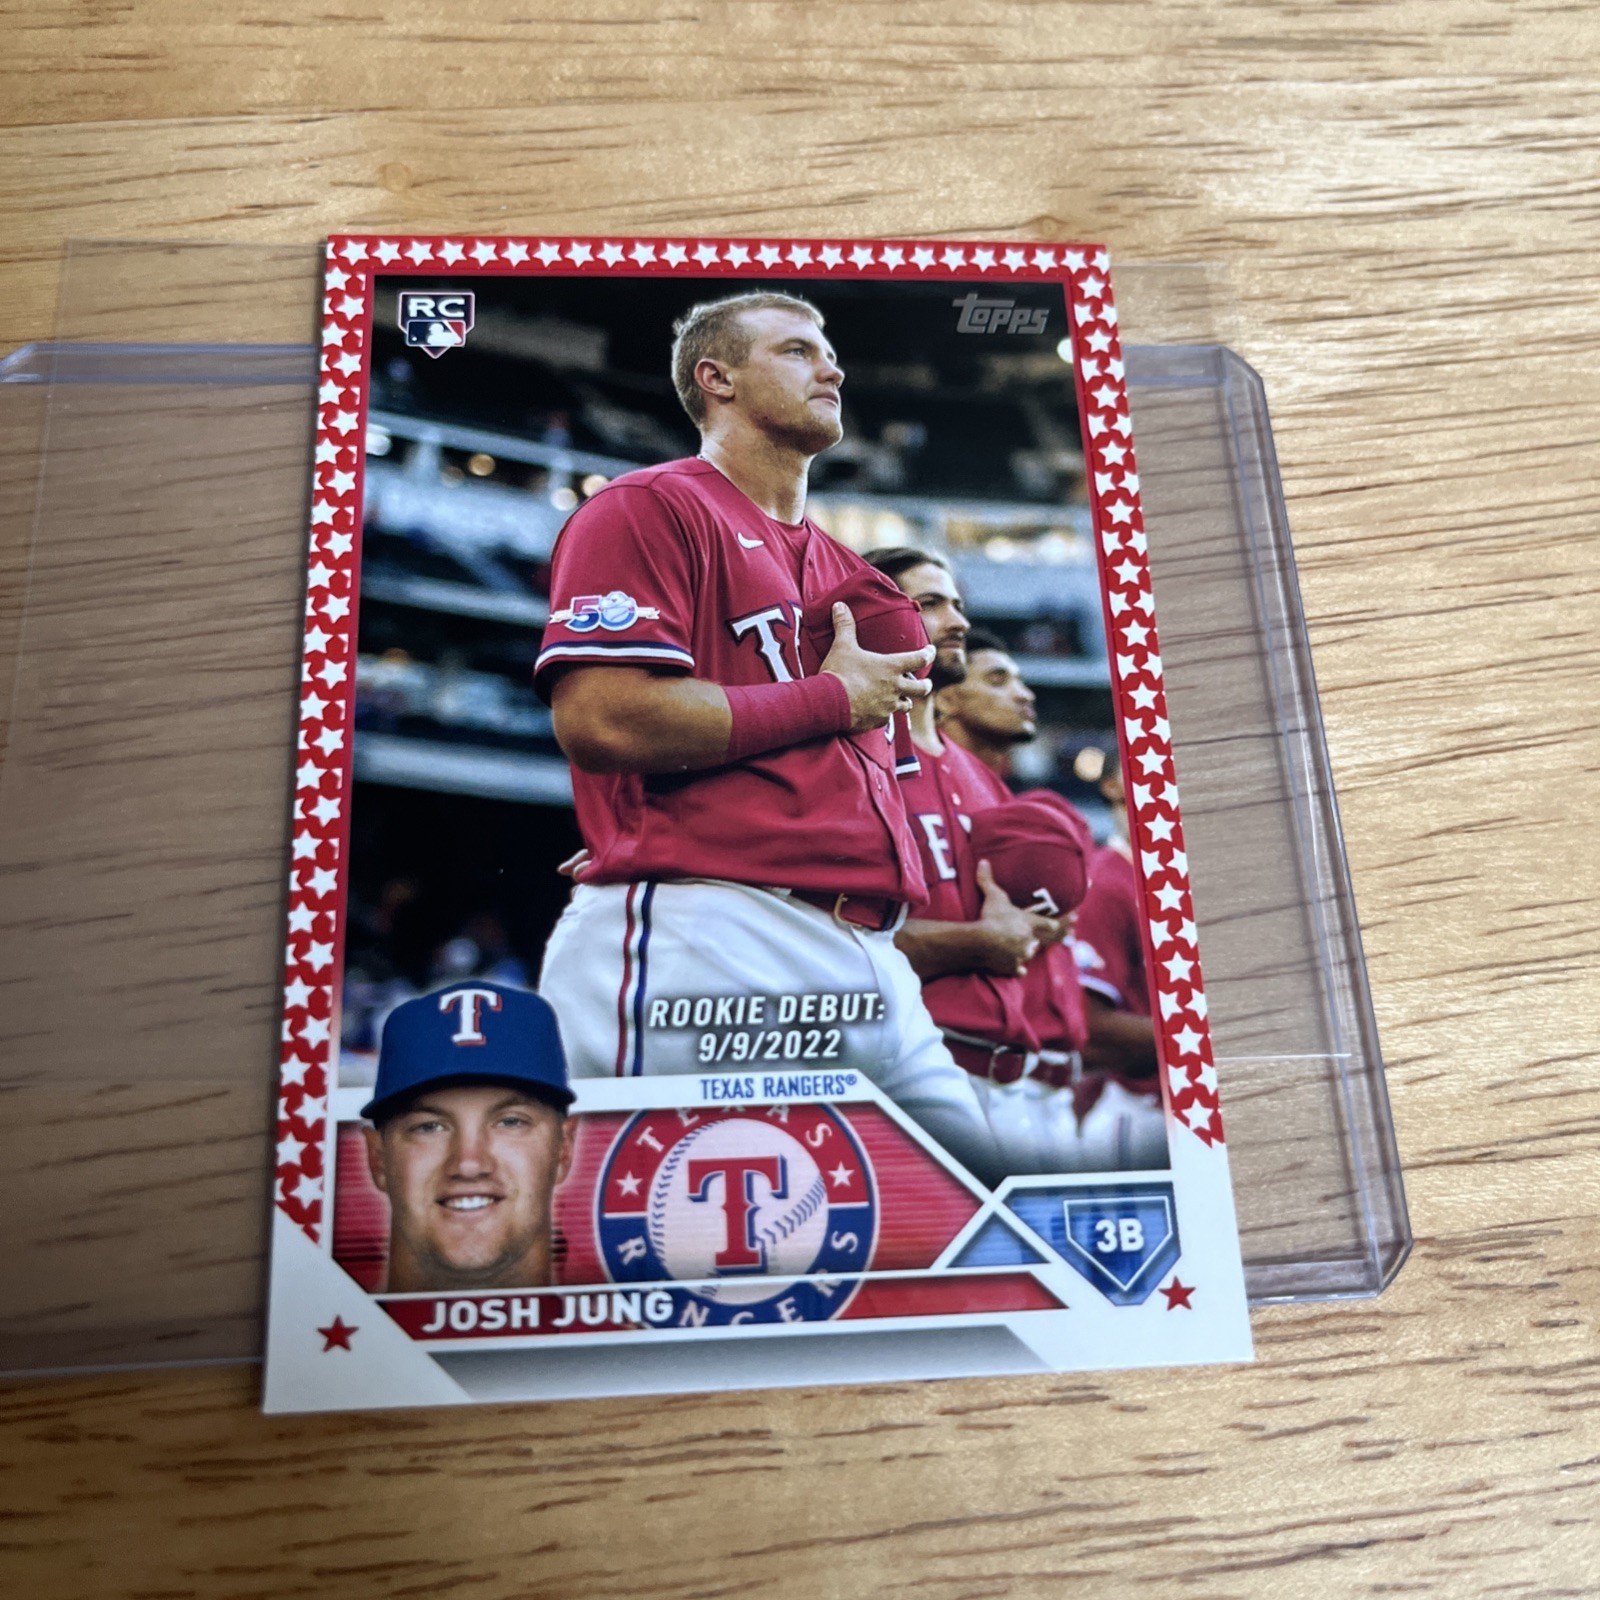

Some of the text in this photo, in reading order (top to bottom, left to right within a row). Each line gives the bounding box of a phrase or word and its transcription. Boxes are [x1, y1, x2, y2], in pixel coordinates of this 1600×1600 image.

[408, 297, 466, 318] RC
[439, 989, 502, 1047] T
[649, 992, 886, 1028] ROOKIE DEBUT:
[698, 1028, 842, 1063] 9/9/2022
[700, 1077, 755, 1100] TEXAS
[687, 1153, 790, 1276] T
[1095, 1217, 1145, 1253] 3B
[421, 1289, 675, 1334] JOSH JUNG
